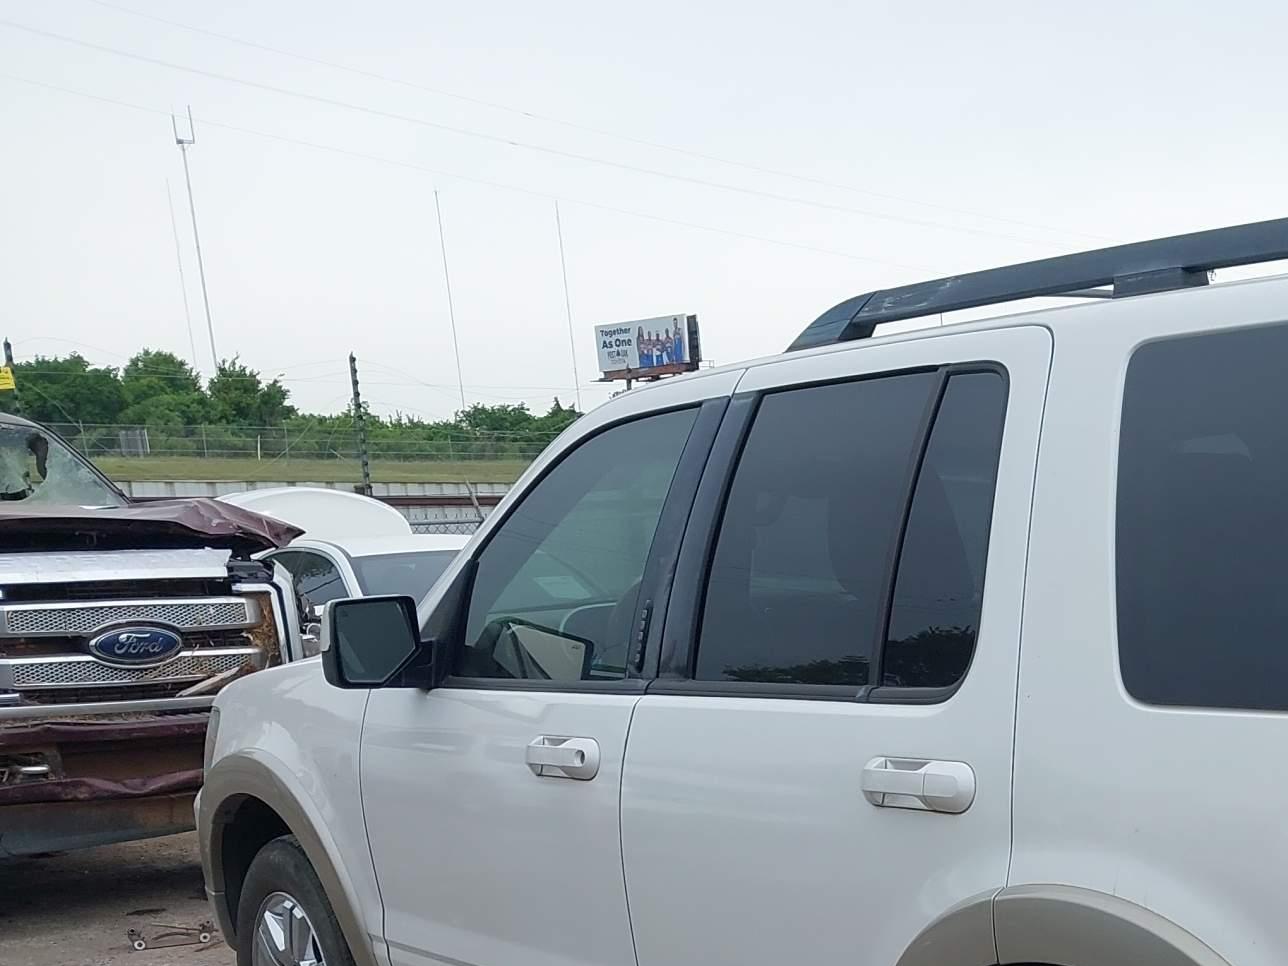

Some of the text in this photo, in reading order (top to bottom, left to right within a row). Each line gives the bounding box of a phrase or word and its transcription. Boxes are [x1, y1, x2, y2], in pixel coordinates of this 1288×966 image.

[600, 327, 631, 338] Together
[602, 338, 632, 349] As One
[114, 633, 164, 655] Ford
